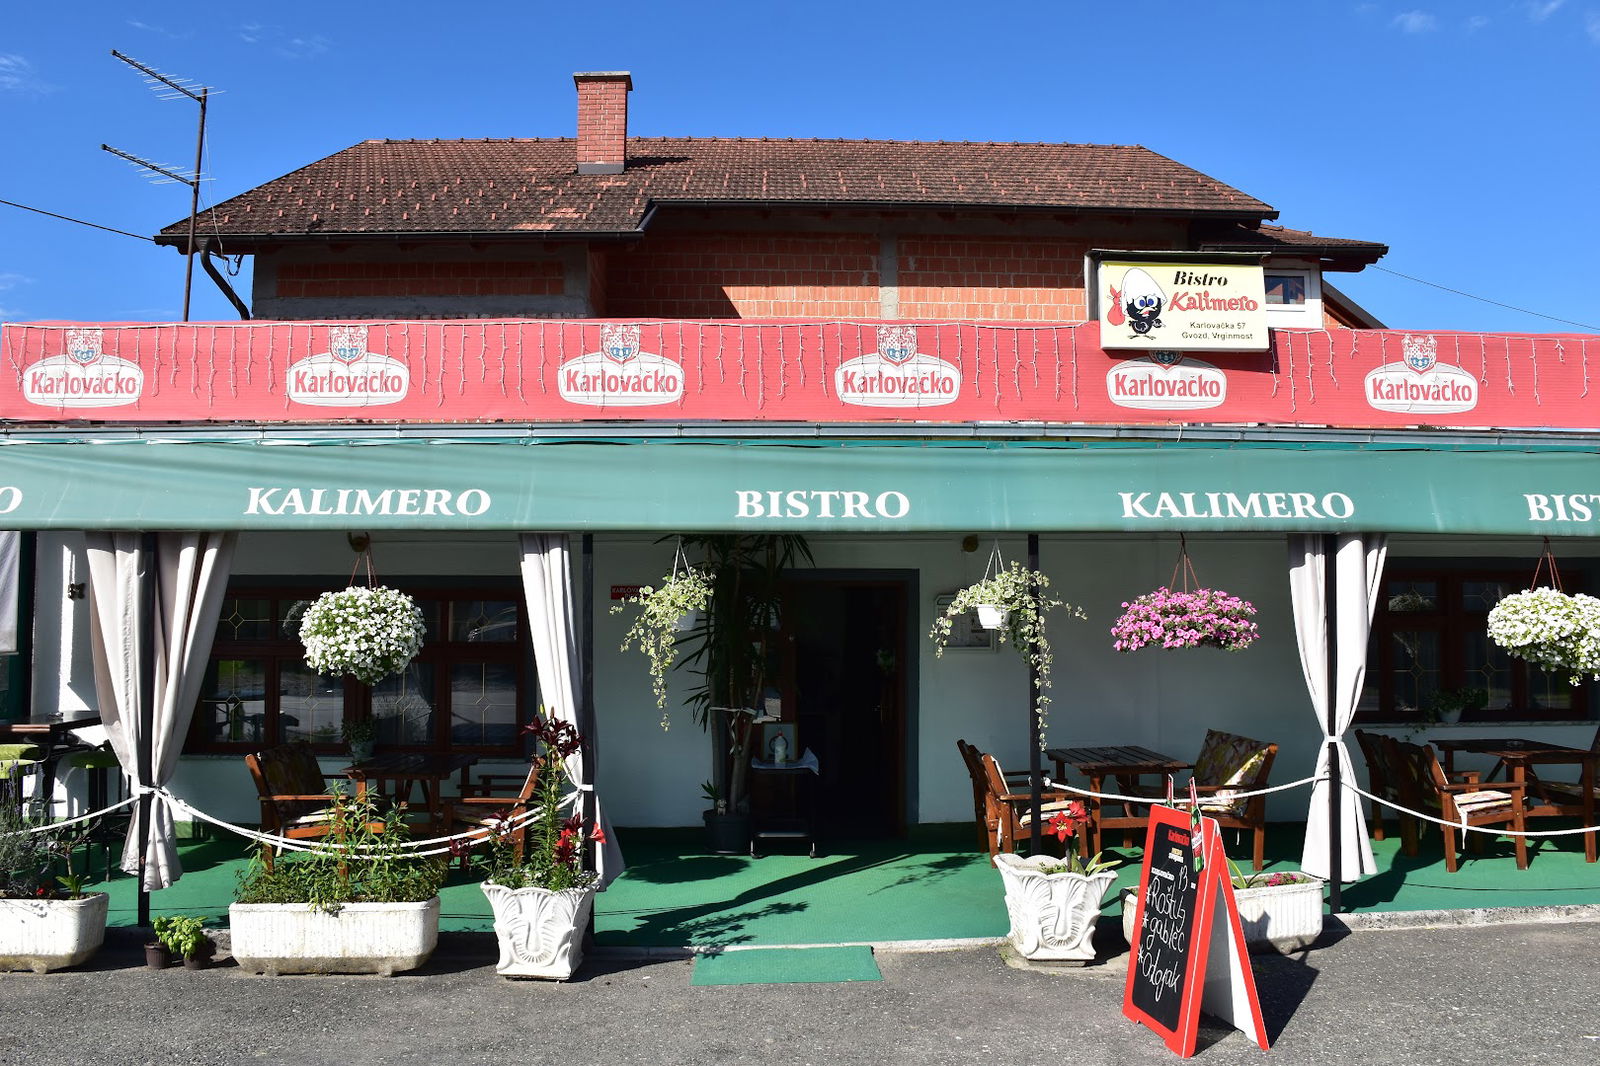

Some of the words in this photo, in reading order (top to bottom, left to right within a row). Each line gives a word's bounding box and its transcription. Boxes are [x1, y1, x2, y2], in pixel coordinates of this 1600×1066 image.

[1173, 270, 1228, 287] Bistro
[1167, 290, 1259, 312] Kalimero
[1181, 331, 1210, 340] Gvozd,
[1211, 331, 1254, 341] Vrginmost
[1189, 321, 1235, 330] Karlovačka
[1236, 322, 1247, 330] 57
[31, 371, 137, 395] Karlovačko
[294, 371, 403, 393] Karlovačko
[566, 370, 678, 393] Karlovačko
[842, 370, 954, 395] Karlovačko
[1114, 373, 1221, 398] Karlovačko
[1371, 377, 1473, 402] Karlovačko
[243, 487, 492, 516] KALIMERO
[735, 490, 910, 519] BISTRO
[1117, 492, 1356, 520] KALIMERO
[1146, 916, 1185, 953] gablec
